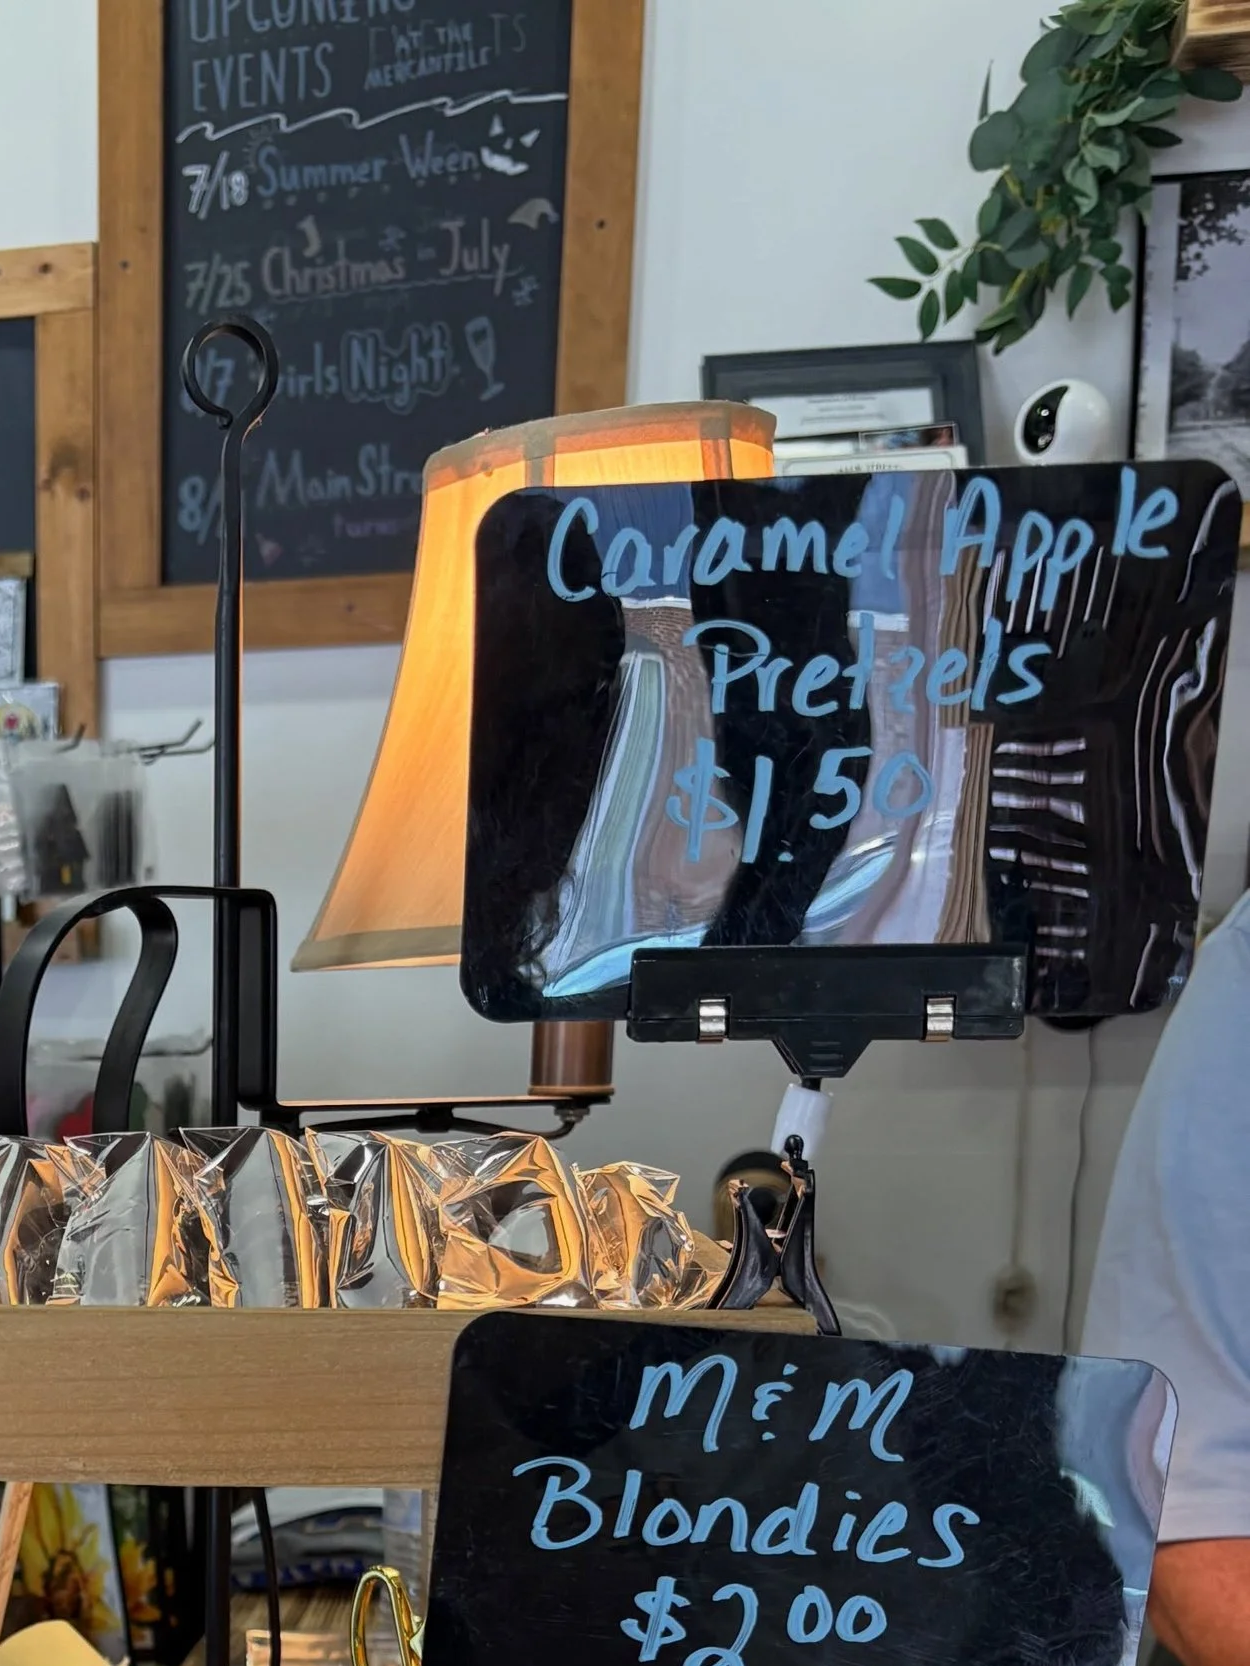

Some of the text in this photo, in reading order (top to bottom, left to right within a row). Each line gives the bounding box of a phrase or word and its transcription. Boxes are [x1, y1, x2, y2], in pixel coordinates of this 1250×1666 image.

[190, 42, 334, 113] EVENTS
[182, 130, 480, 219] 7/18 Summer Ween
[184, 252, 251, 315] 7/25
[261, 238, 406, 297] Christmas
[439, 217, 511, 297] July
[350, 328, 449, 408] Night
[255, 448, 350, 510] Main
[546, 466, 1179, 612] Caramel Apple
[682, 618, 1052, 718] Pretzels
[665, 737, 936, 865] $1.50
[629, 1354, 738, 1453] M
[809, 1369, 915, 1463] M
[513, 1455, 980, 1569] Blondies
